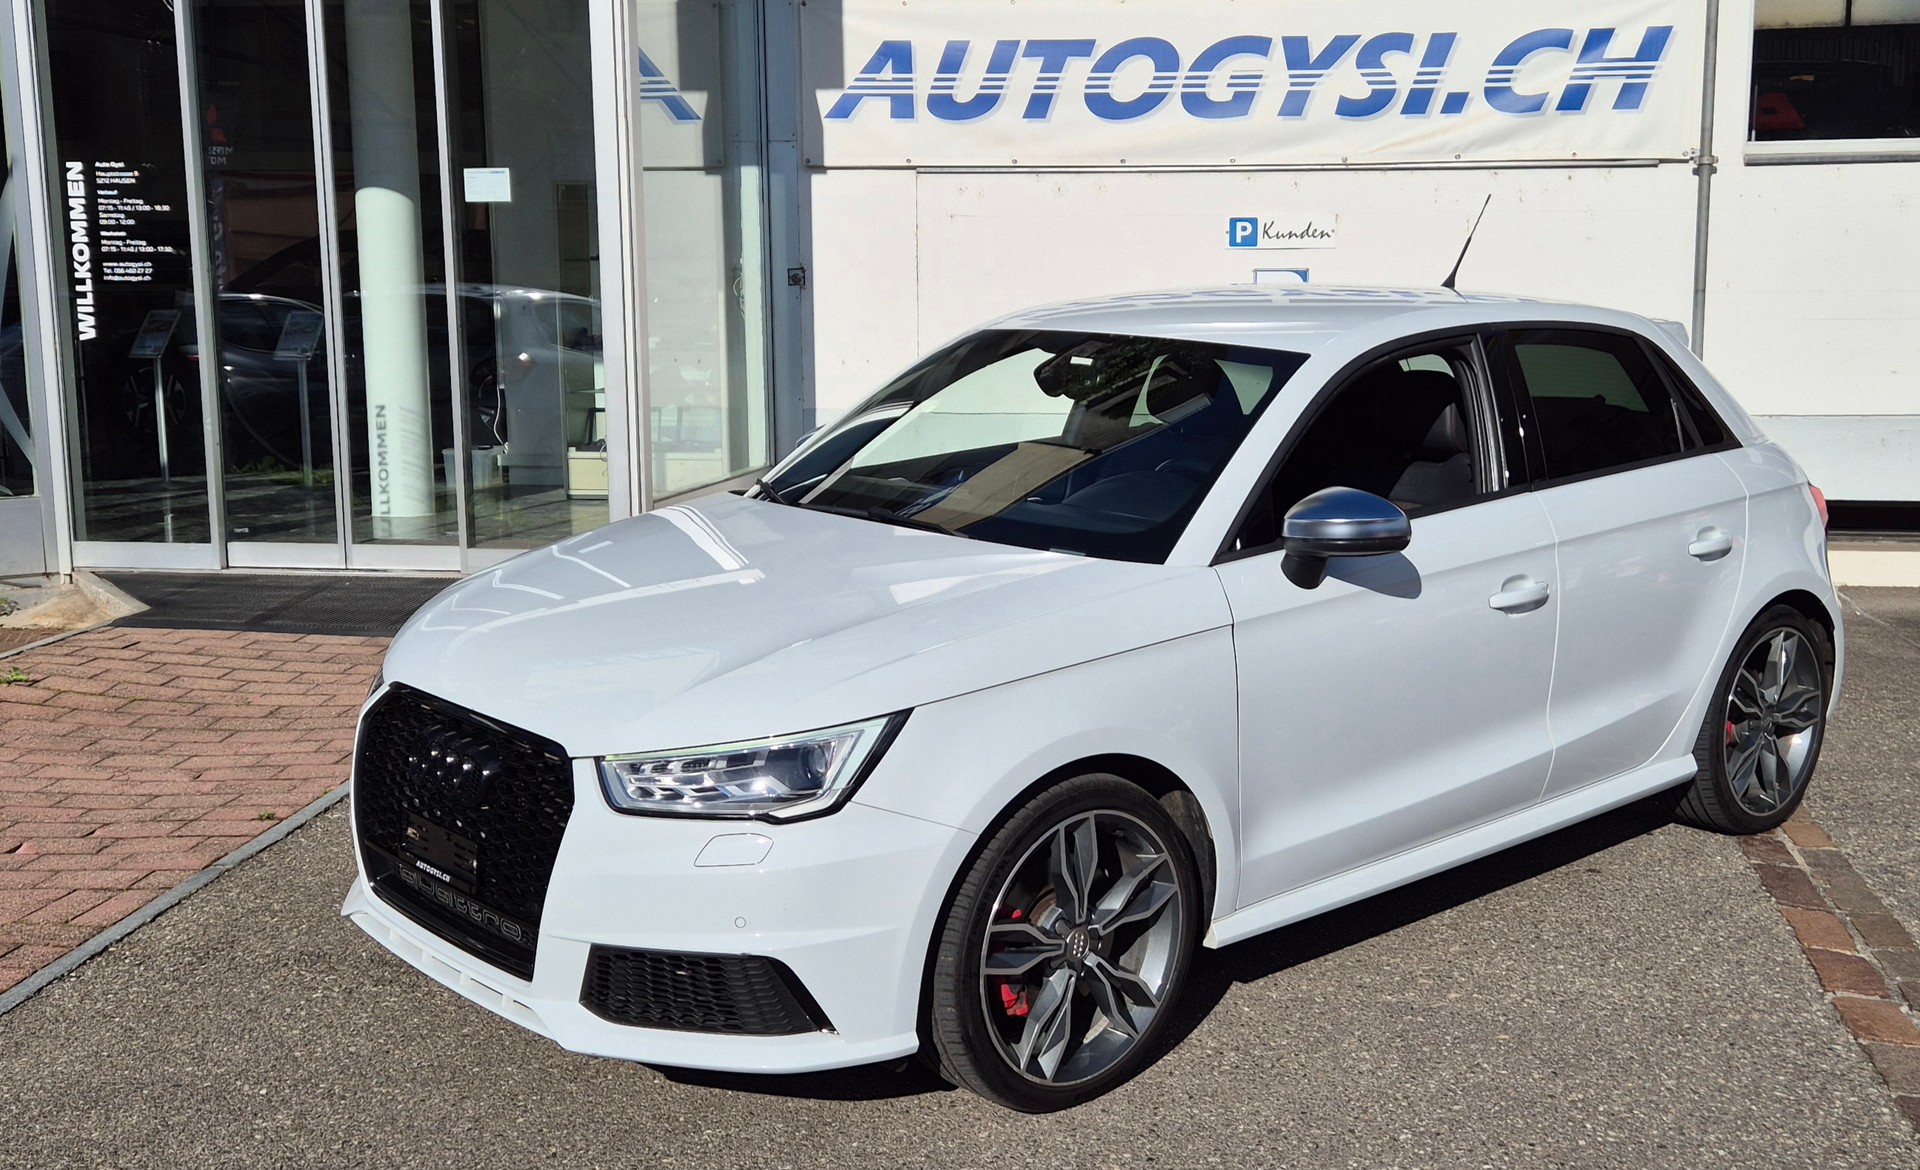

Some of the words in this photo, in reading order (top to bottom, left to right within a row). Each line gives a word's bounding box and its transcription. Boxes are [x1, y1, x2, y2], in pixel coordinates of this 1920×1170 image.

[824, 25, 1675, 122] AUTOGYSI.CH
[65, 161, 97, 341] WILLKOMMEN
[1262, 220, 1331, 240] Kunden
